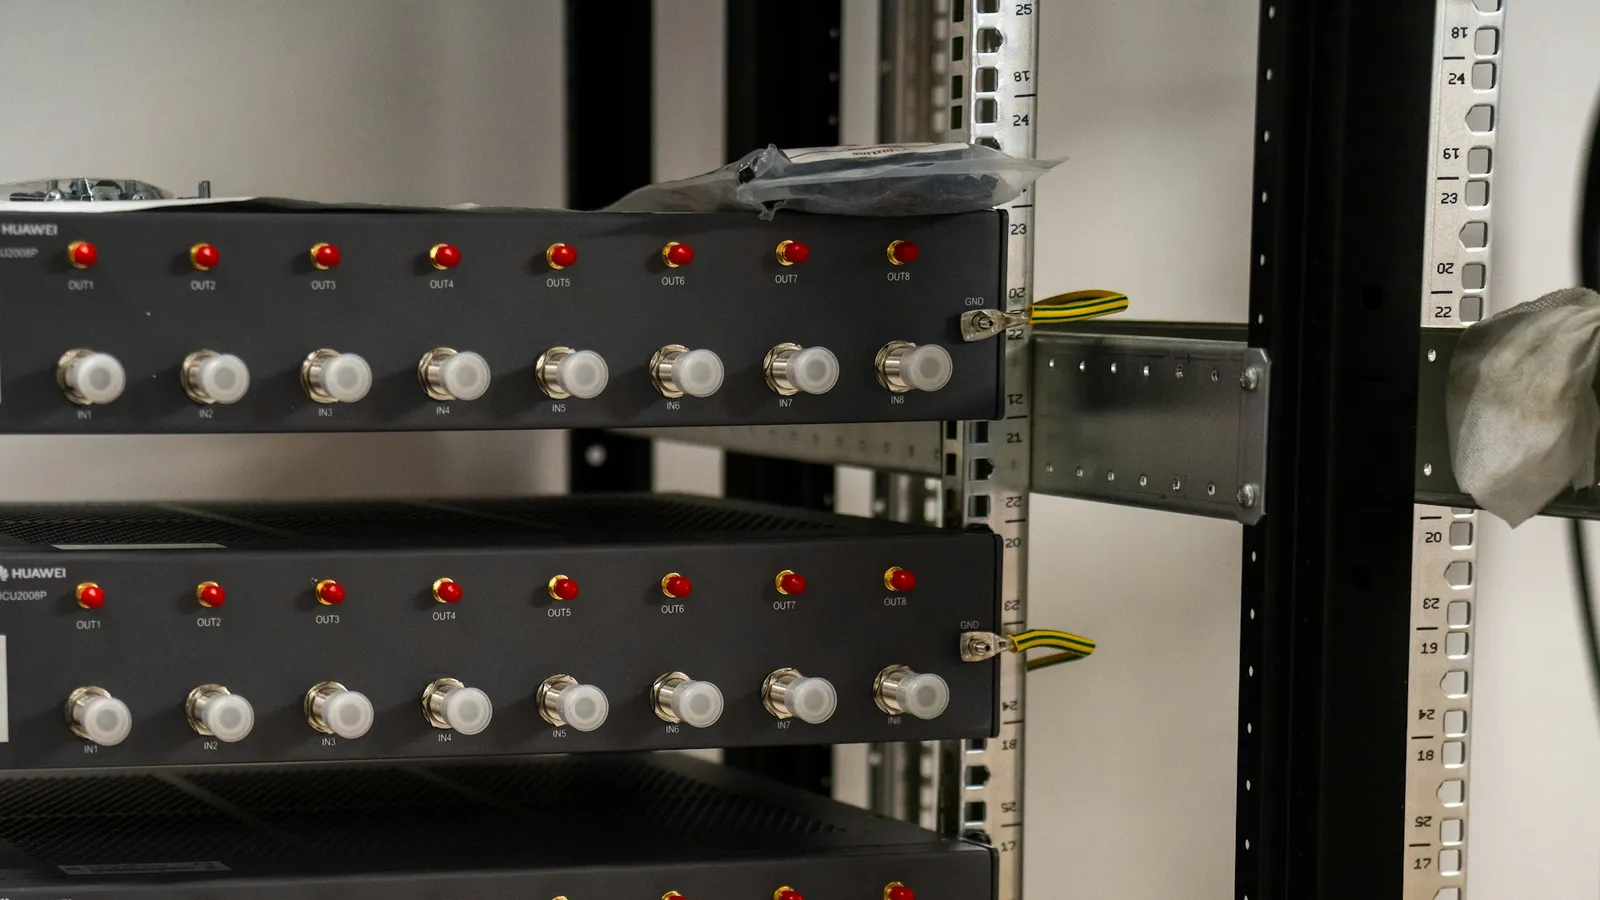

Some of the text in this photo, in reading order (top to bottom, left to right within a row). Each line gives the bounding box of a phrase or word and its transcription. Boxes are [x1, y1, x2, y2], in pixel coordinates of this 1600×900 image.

[1016, 4, 1032, 15] 25
[1452, 27, 1468, 39] 18
[1014, 71, 1029, 82] 18
[1449, 73, 1465, 84] 24
[1013, 114, 1029, 126] 24
[1443, 148, 1459, 159] 19
[1441, 193, 1458, 204] 23
[1, 223, 58, 236] HUAWEI
[1010, 223, 1027, 235] 23
[1437, 263, 1454, 274] 20
[662, 277, 685, 286] OUT6
[775, 275, 798, 284] OUT7
[887, 272, 911, 282] OUT8
[68, 280, 94, 291] OUT1
[191, 280, 216, 291] OUT2
[311, 280, 337, 291] OUT3
[430, 280, 454, 290] OUT4
[547, 278, 571, 288] OUT5
[1008, 287, 1025, 299] 20
[964, 297, 984, 306] GND
[1435, 307, 1451, 318] 22
[1007, 328, 1024, 340] 22
[780, 399, 793, 408] IN7
[891, 396, 905, 405] IN8
[1007, 393, 1023, 405] 21
[437, 407, 450, 415] IN4
[552, 404, 567, 413] IN5
[667, 402, 681, 411] IN6
[78, 411, 92, 420] IN1
[199, 409, 214, 419] IN2
[319, 408, 333, 417] IN3
[1006, 433, 1022, 443] 21
[1005, 496, 1022, 508] 22
[1005, 537, 1020, 548] 20
[1426, 532, 1441, 543] 20
[12, 567, 67, 579] HUAWEI
[773, 601, 796, 611] OUT7
[884, 597, 907, 607] OUT8
[1004, 600, 1020, 611] 23
[1423, 598, 1439, 609] 23
[548, 608, 572, 618] OUT5
[661, 605, 685, 614] OUT6
[316, 615, 340, 625] OUT3
[433, 612, 456, 621] OUT4
[76, 620, 101, 630] OUT1
[197, 618, 222, 628] OUT2
[960, 620, 979, 630] GND
[1421, 643, 1437, 654] 19
[1002, 700, 1018, 711] 24
[1419, 709, 1435, 720] 24
[777, 720, 791, 729] IN7
[887, 716, 901, 725] IN8
[553, 730, 567, 738] IN5
[665, 724, 680, 734] IN6
[322, 738, 336, 746] IN3
[439, 734, 452, 742] IN4
[84, 744, 98, 754] IN1
[204, 742, 218, 751] IN2
[1001, 739, 1017, 750] 18
[1418, 750, 1434, 761] 18
[1001, 802, 1017, 813] 25
[1415, 816, 1432, 827] 25
[1001, 841, 1016, 852] 17
[1414, 858, 1431, 869] 17
